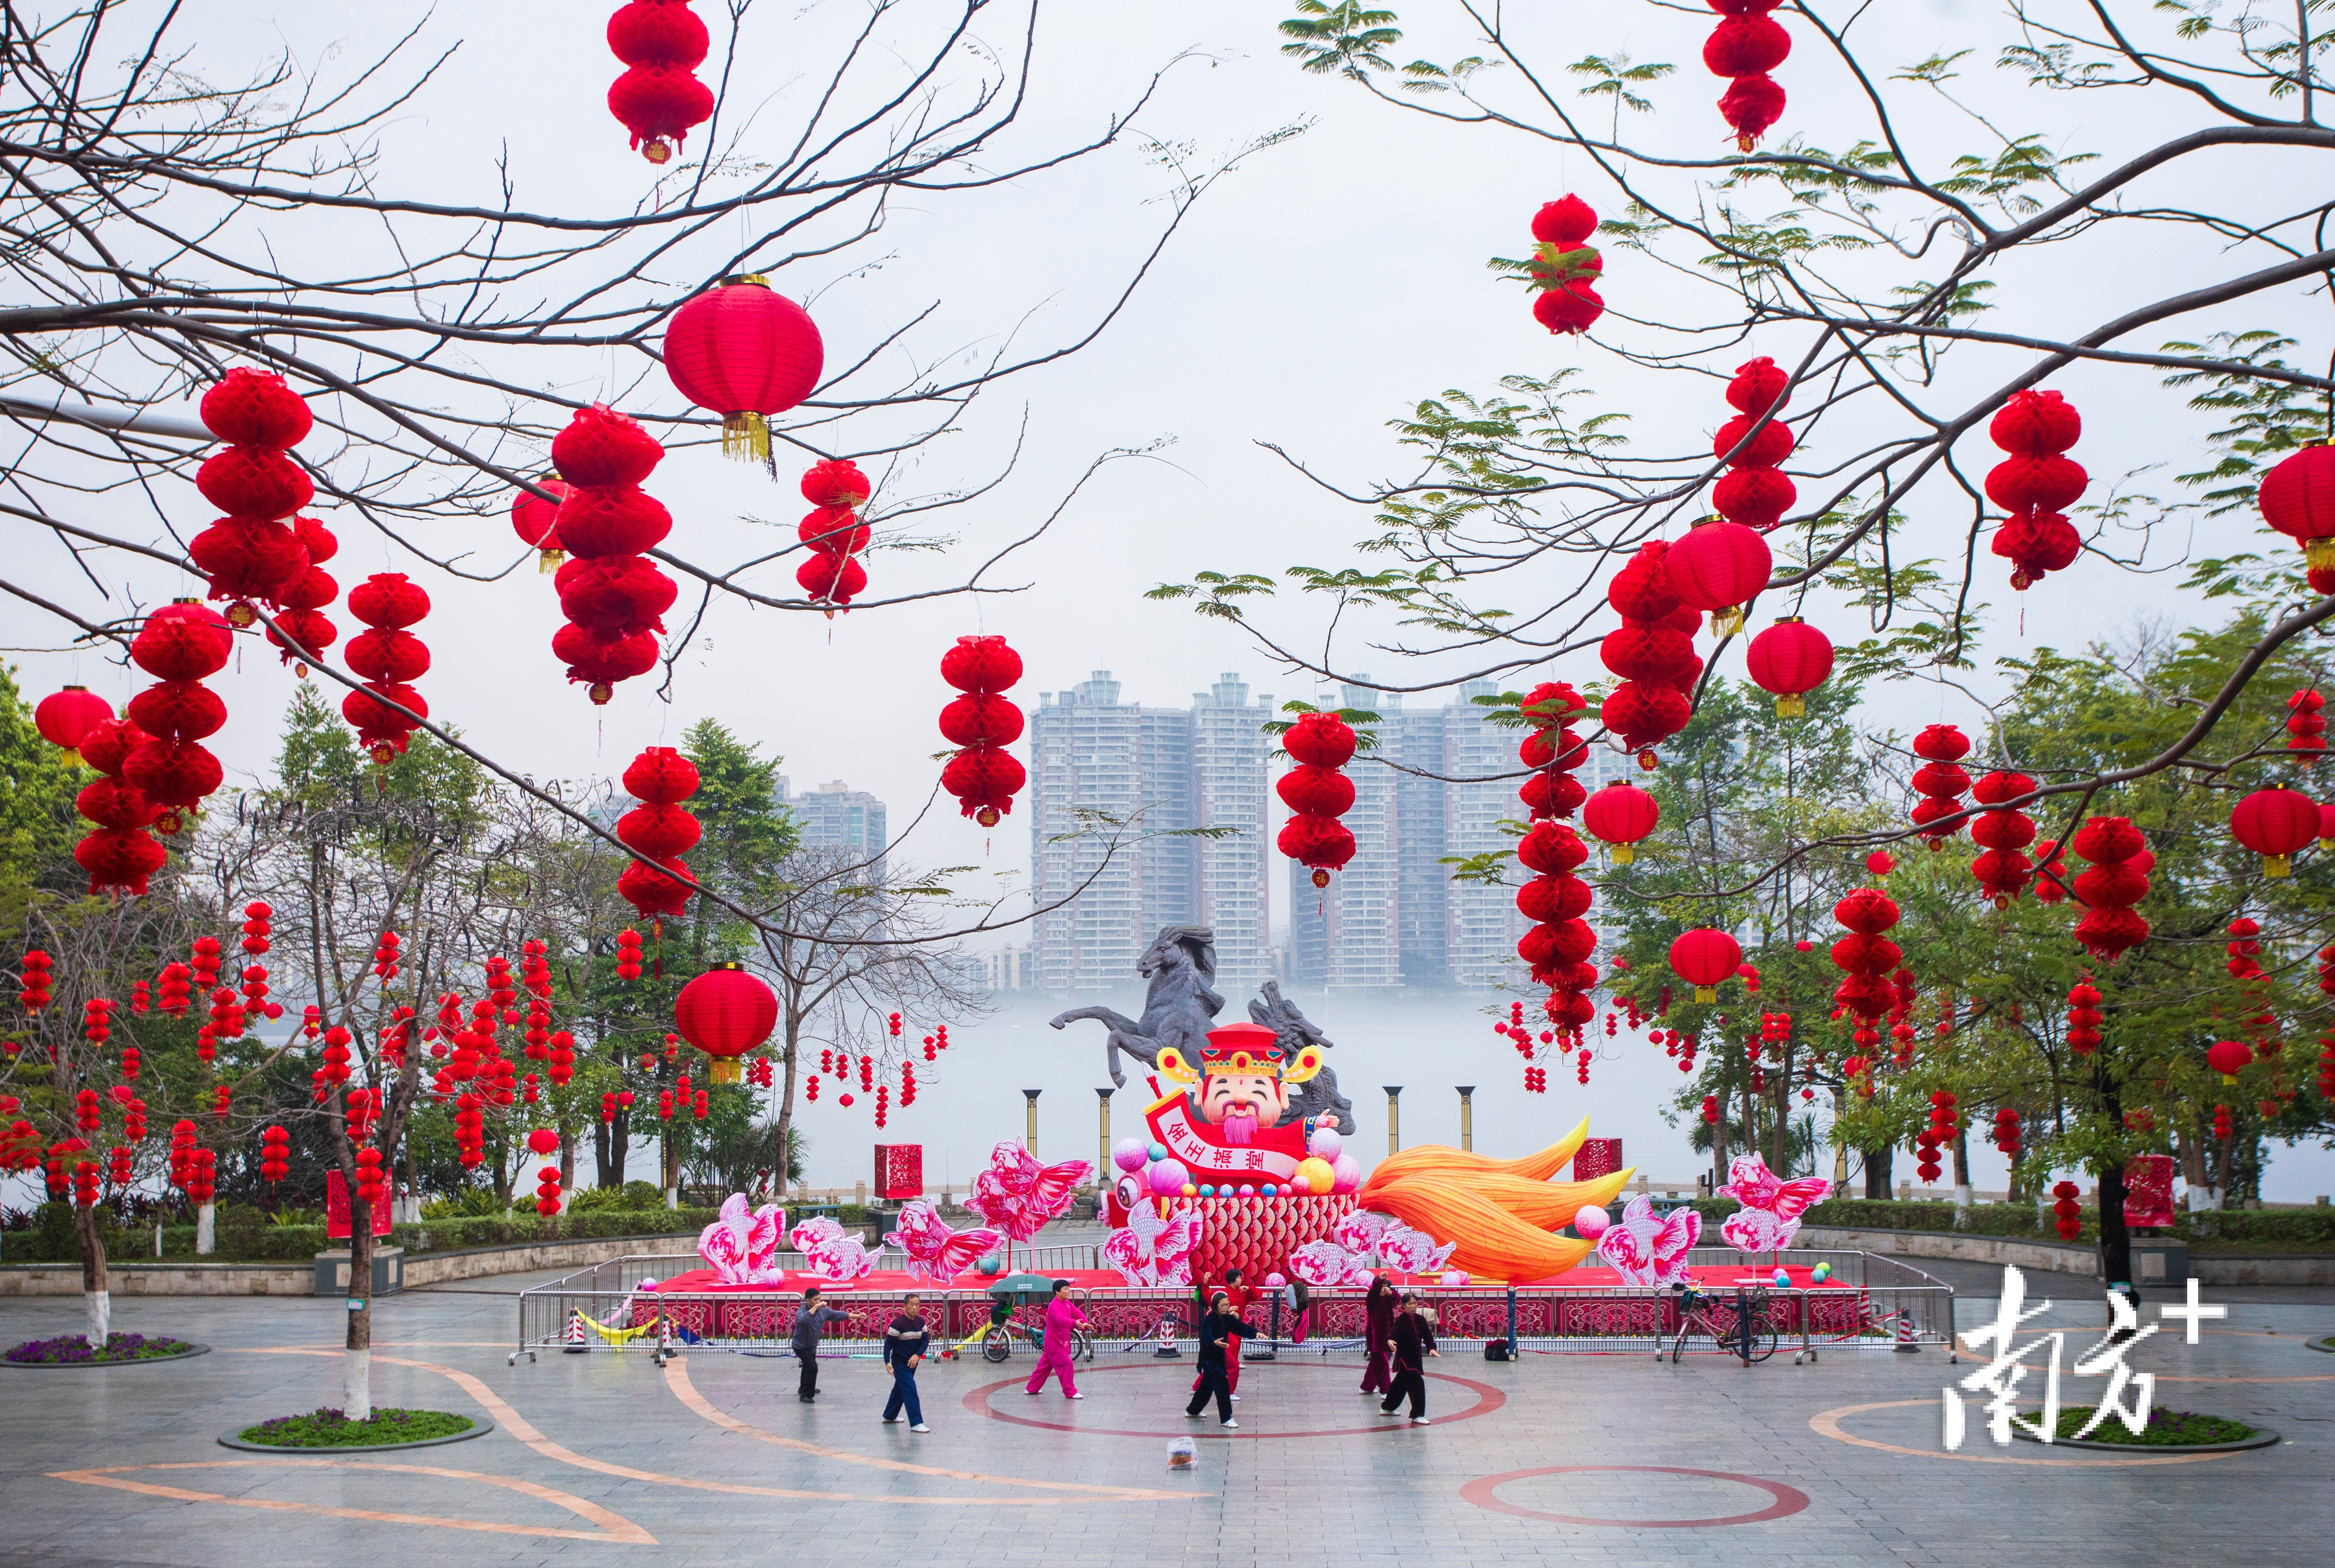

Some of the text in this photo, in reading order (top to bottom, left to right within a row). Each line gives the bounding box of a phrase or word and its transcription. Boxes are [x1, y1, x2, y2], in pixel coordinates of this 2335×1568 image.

[1741, 136, 1751, 150] 福
[375, 749, 390, 760] 福
[1642, 754, 1654, 767] 福
[160, 817, 177, 830] 福
[1316, 873, 1326, 884] 福
[1558, 1028, 1568, 1036] 福
